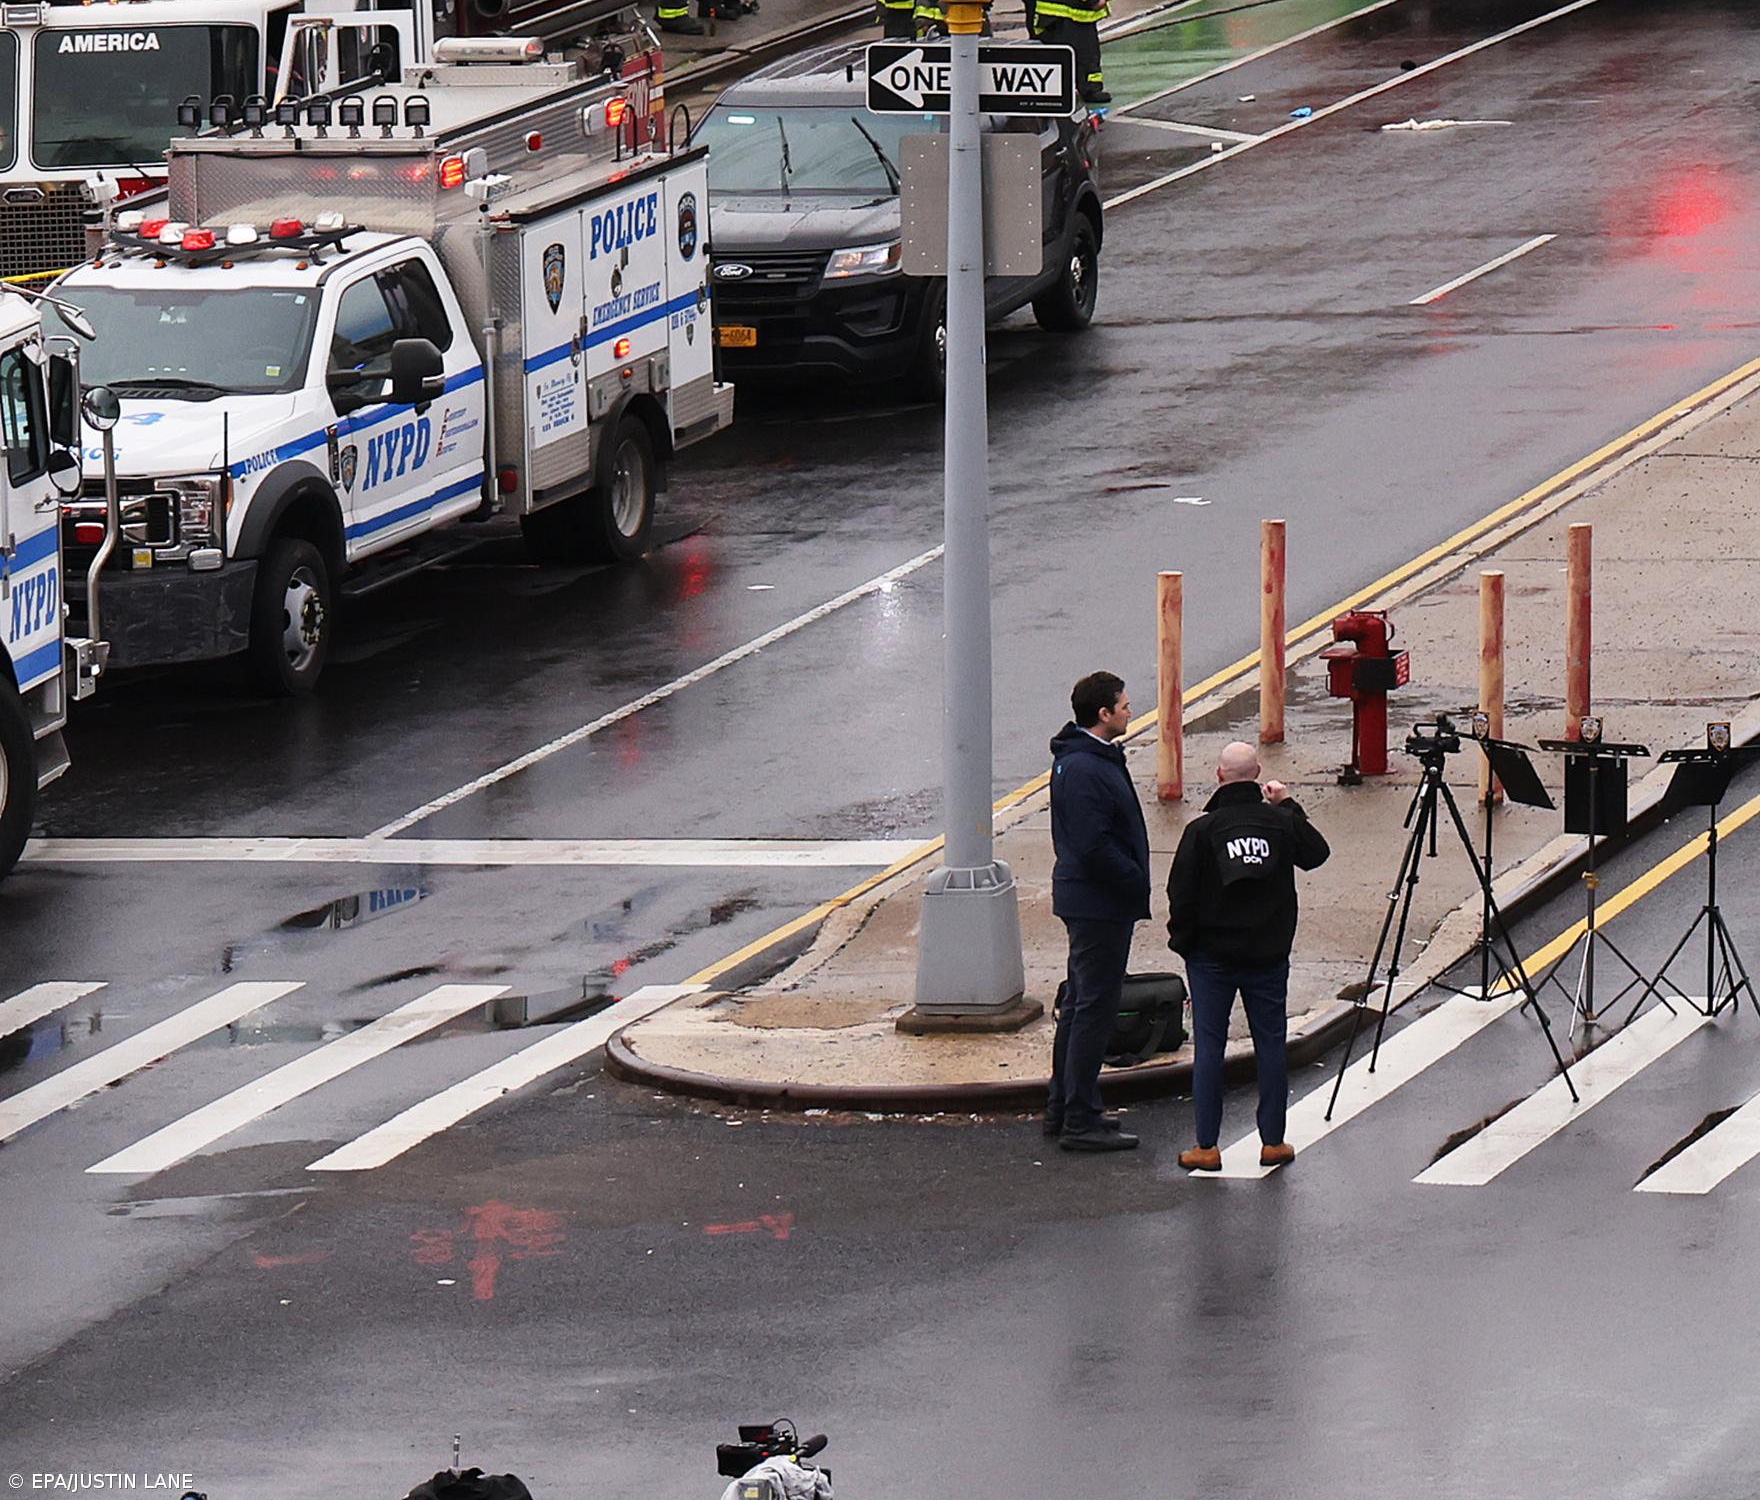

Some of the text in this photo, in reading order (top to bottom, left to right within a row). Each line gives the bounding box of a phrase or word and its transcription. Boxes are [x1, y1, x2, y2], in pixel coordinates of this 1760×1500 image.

[58, 32, 160, 54] AMERICA
[890, 66, 1055, 93] ONE WAY
[589, 191, 658, 261] POLICE
[244, 448, 277, 475] POLICE
[362, 420, 432, 492] NYPD
[10, 567, 58, 643] NYPD
[1226, 835, 1271, 861] NYPD
